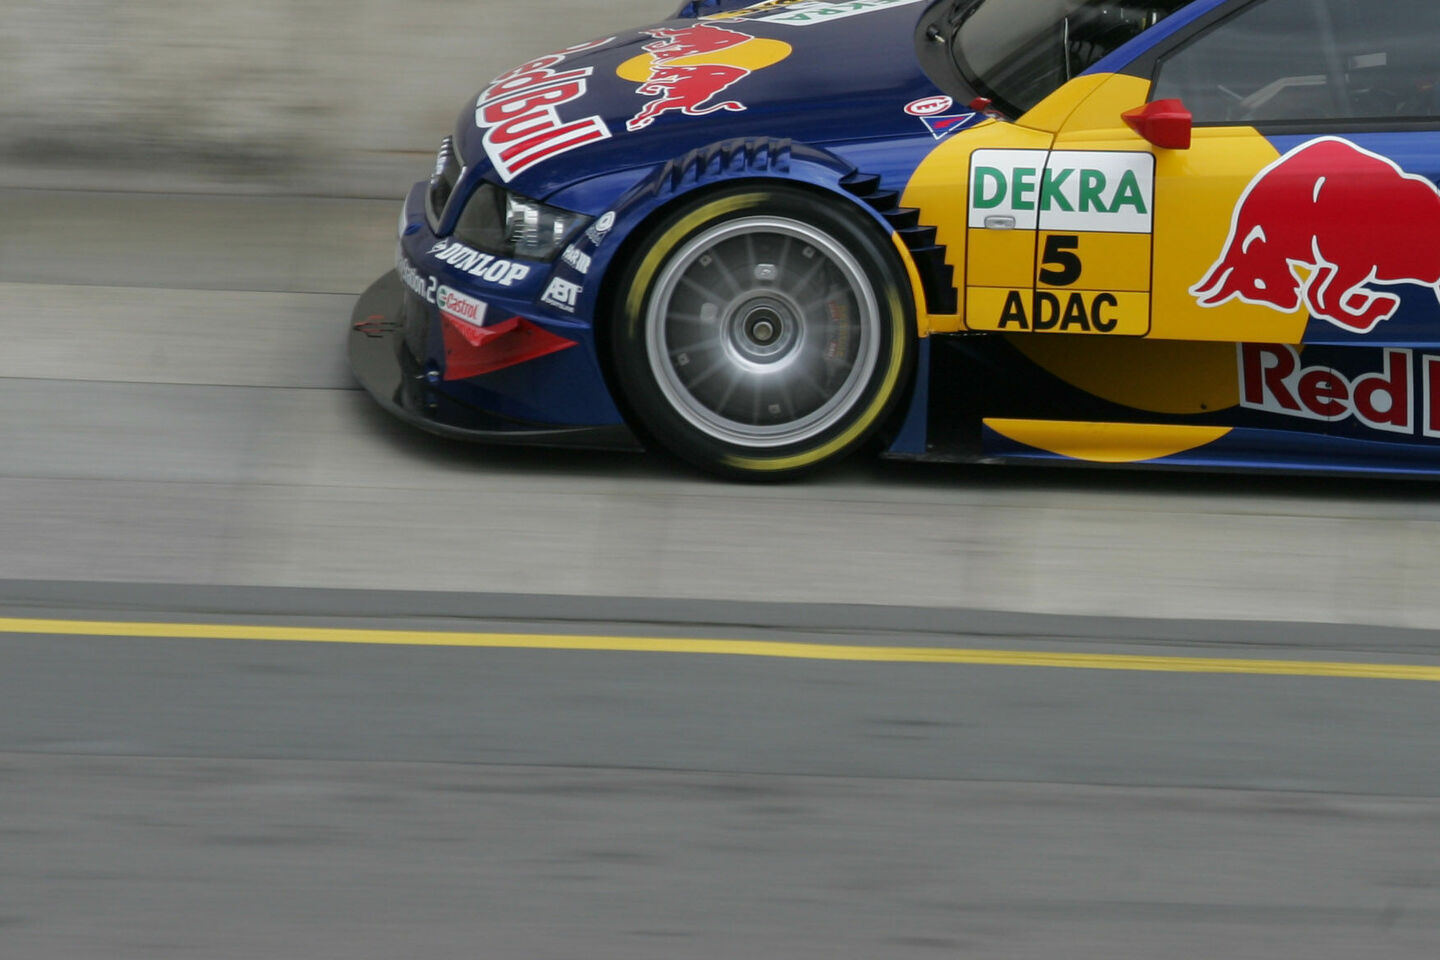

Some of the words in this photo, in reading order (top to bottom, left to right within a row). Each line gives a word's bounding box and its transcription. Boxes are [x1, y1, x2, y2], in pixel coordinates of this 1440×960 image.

[973, 166, 1147, 214] DEKRA
[435, 243, 531, 286] DUNLOP
[1038, 234, 1082, 286] 5
[446, 293, 478, 320] Castrol
[541, 276, 577, 306] ABT
[997, 290, 1118, 332] ADAC
[1240, 342, 1412, 431] Red
